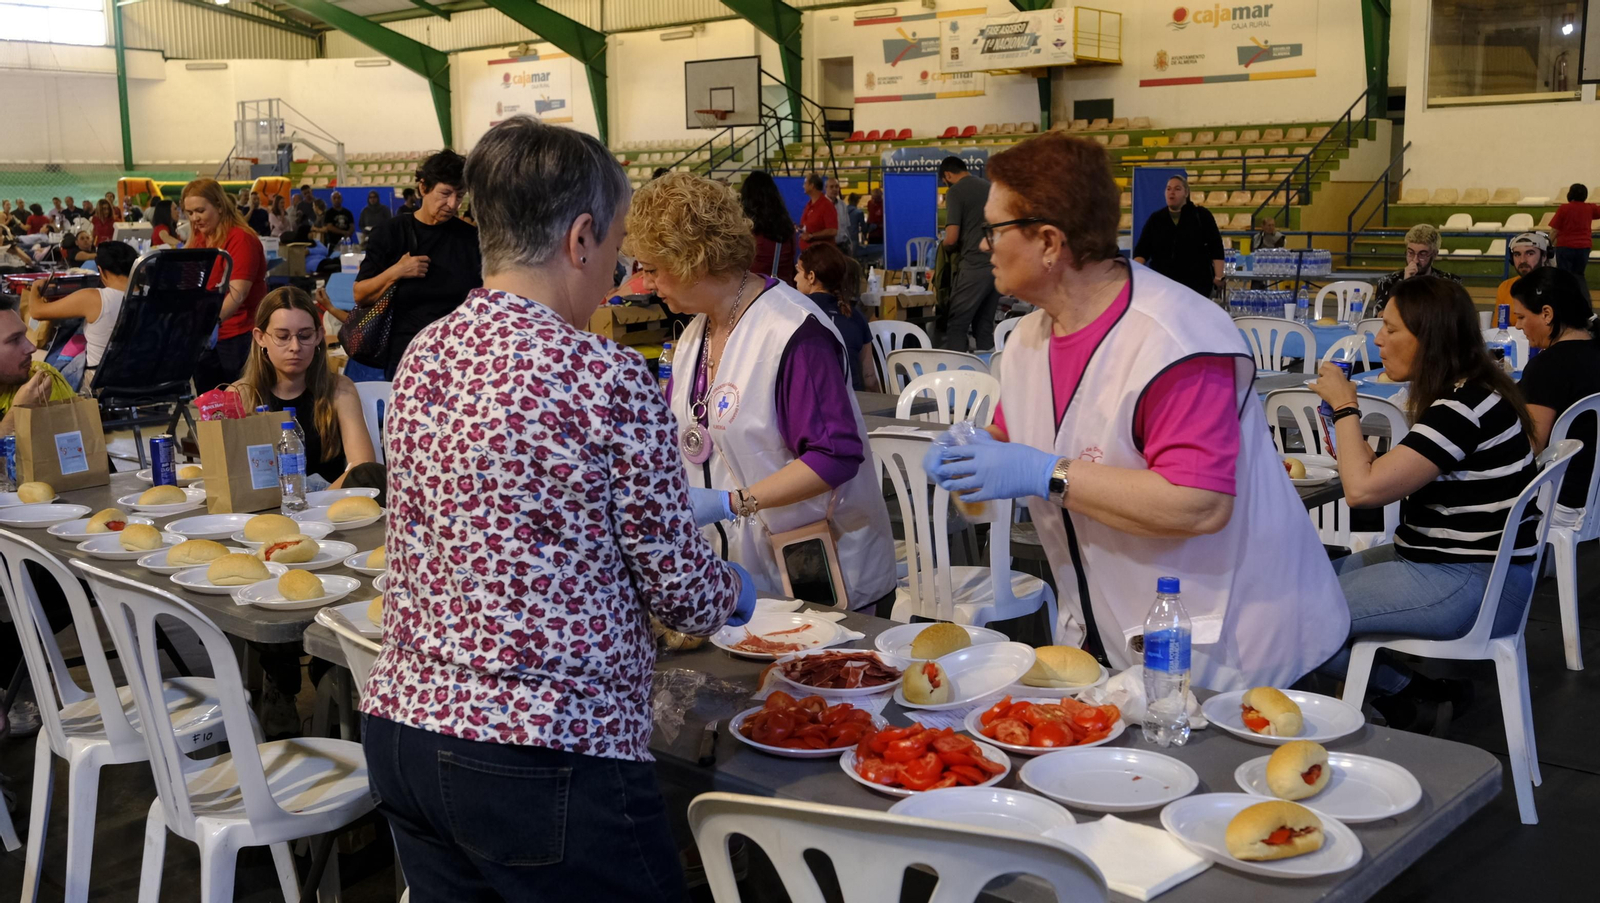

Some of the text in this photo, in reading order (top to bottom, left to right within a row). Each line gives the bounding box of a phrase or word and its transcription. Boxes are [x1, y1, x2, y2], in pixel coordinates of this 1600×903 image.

[1192, 3, 1273, 28] cajamar
[986, 22, 1027, 35] FASE ASCENSO
[1231, 20, 1271, 30] CAJA RURAL
[992, 35, 1031, 51] NACIONAL
[513, 70, 551, 88] cajamar
